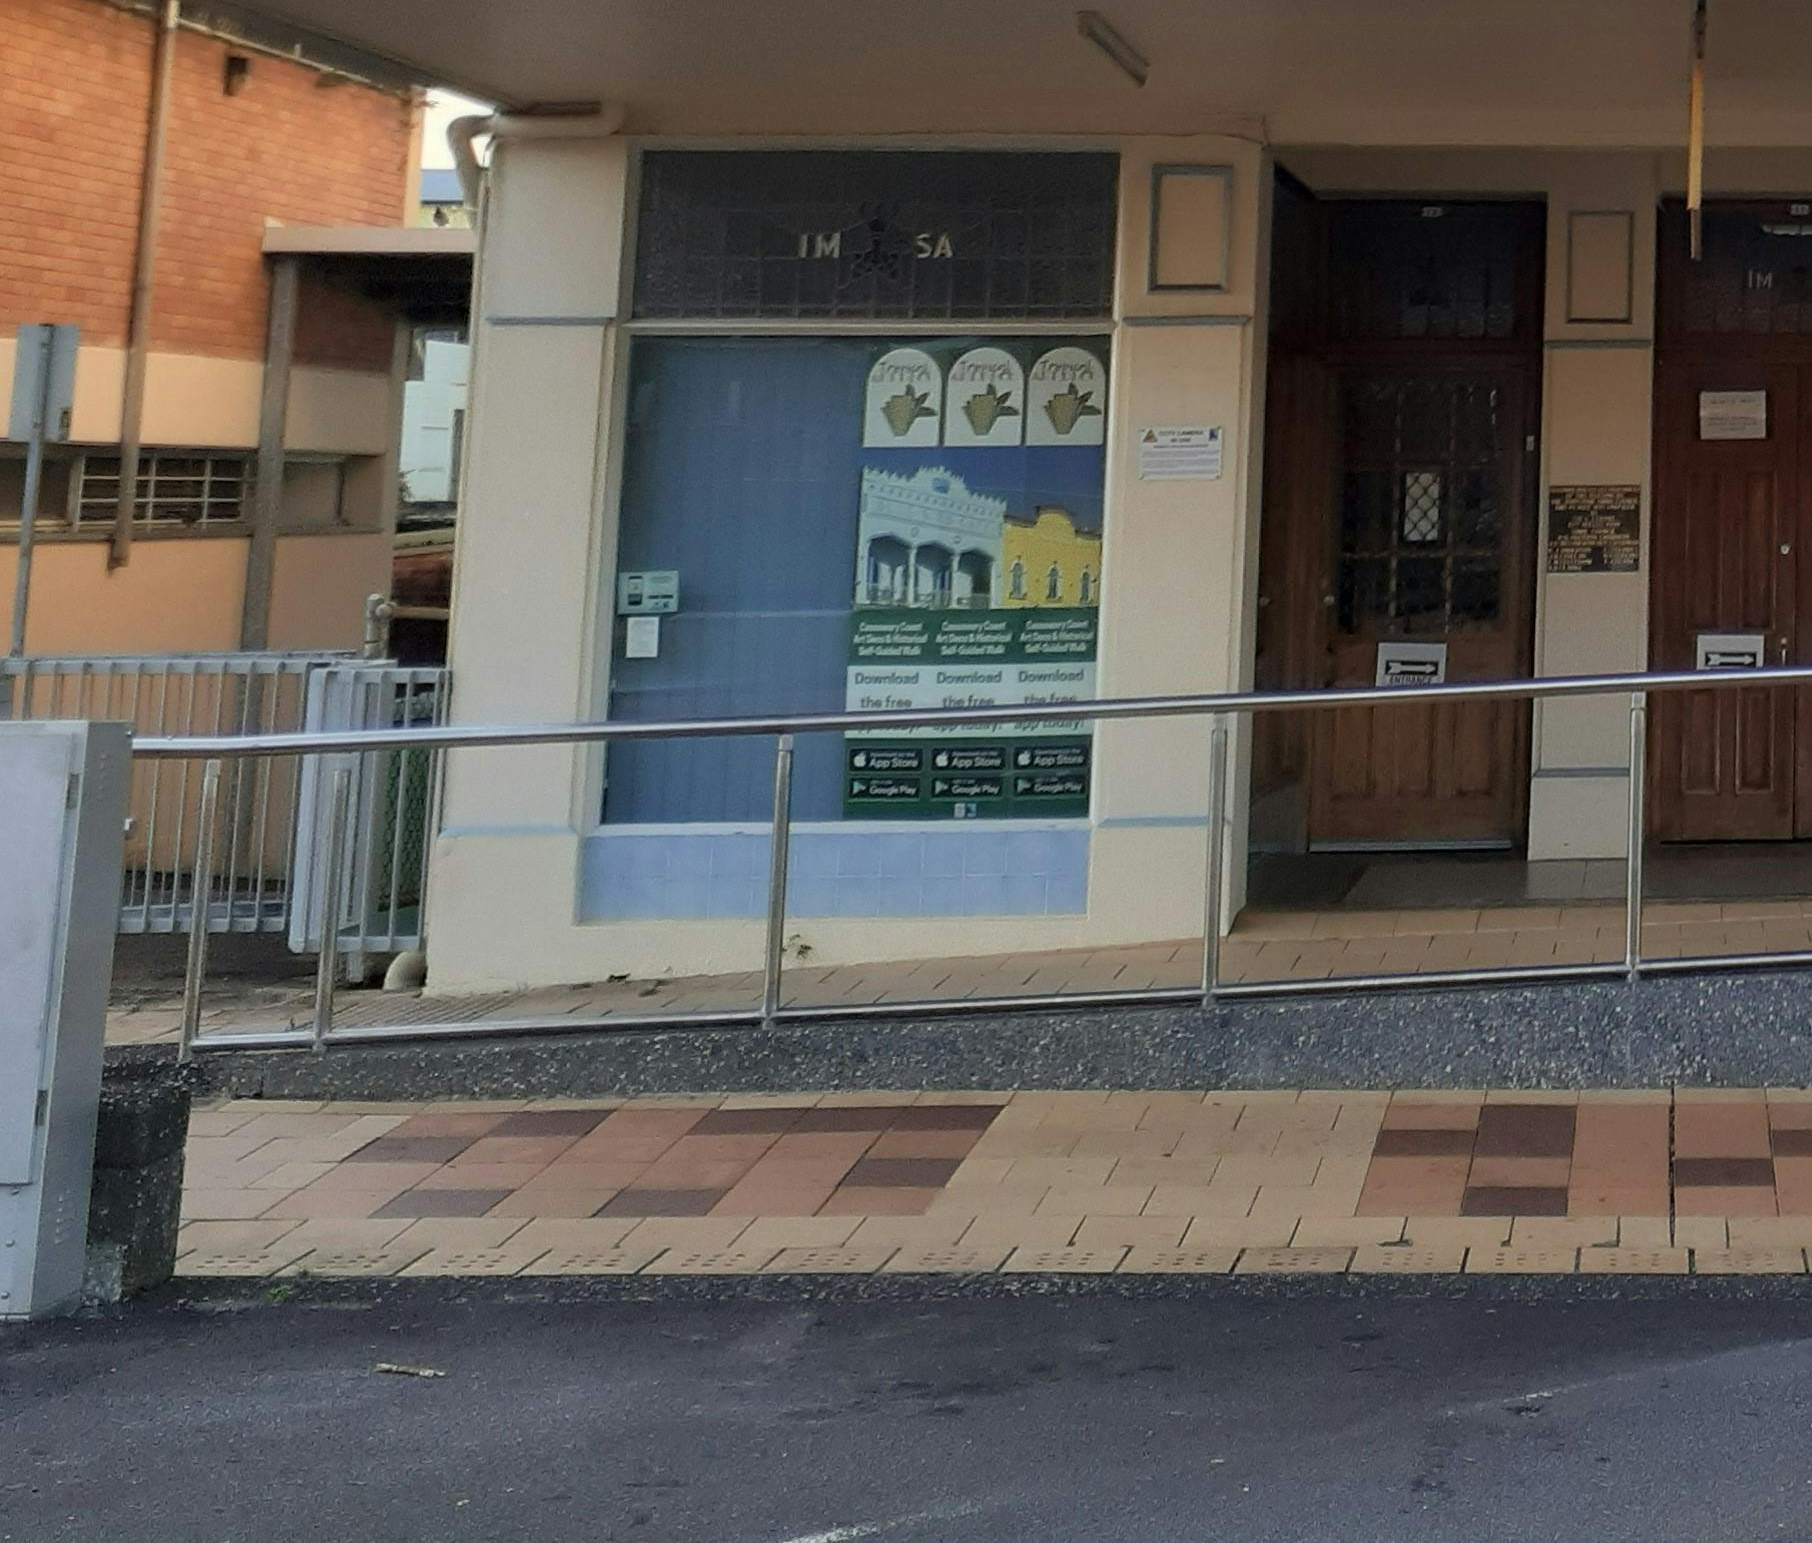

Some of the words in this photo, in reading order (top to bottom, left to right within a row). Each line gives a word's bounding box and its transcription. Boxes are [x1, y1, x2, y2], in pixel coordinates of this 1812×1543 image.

[855, 672, 919, 685] Download
[936, 671, 1002, 684] Download
[1018, 669, 1084, 683] Download
[860, 695, 883, 708] the
[885, 695, 912, 708] free
[942, 694, 967, 707] the
[968, 695, 995, 706] free
[1014, 720, 1039, 732] app
[869, 758, 890, 769] App
[891, 757, 918, 768] Store
[952, 757, 973, 768] App
[974, 756, 1002, 767] Store
[1033, 755, 1055, 767] App
[1056, 754, 1084, 765] Store
[869, 785, 899, 796] Google
[900, 786, 916, 795] Play
[951, 785, 980, 796] Google
[981, 785, 999, 795] Play
[1033, 783, 1063, 794] Google
[1064, 784, 1082, 793] Play
